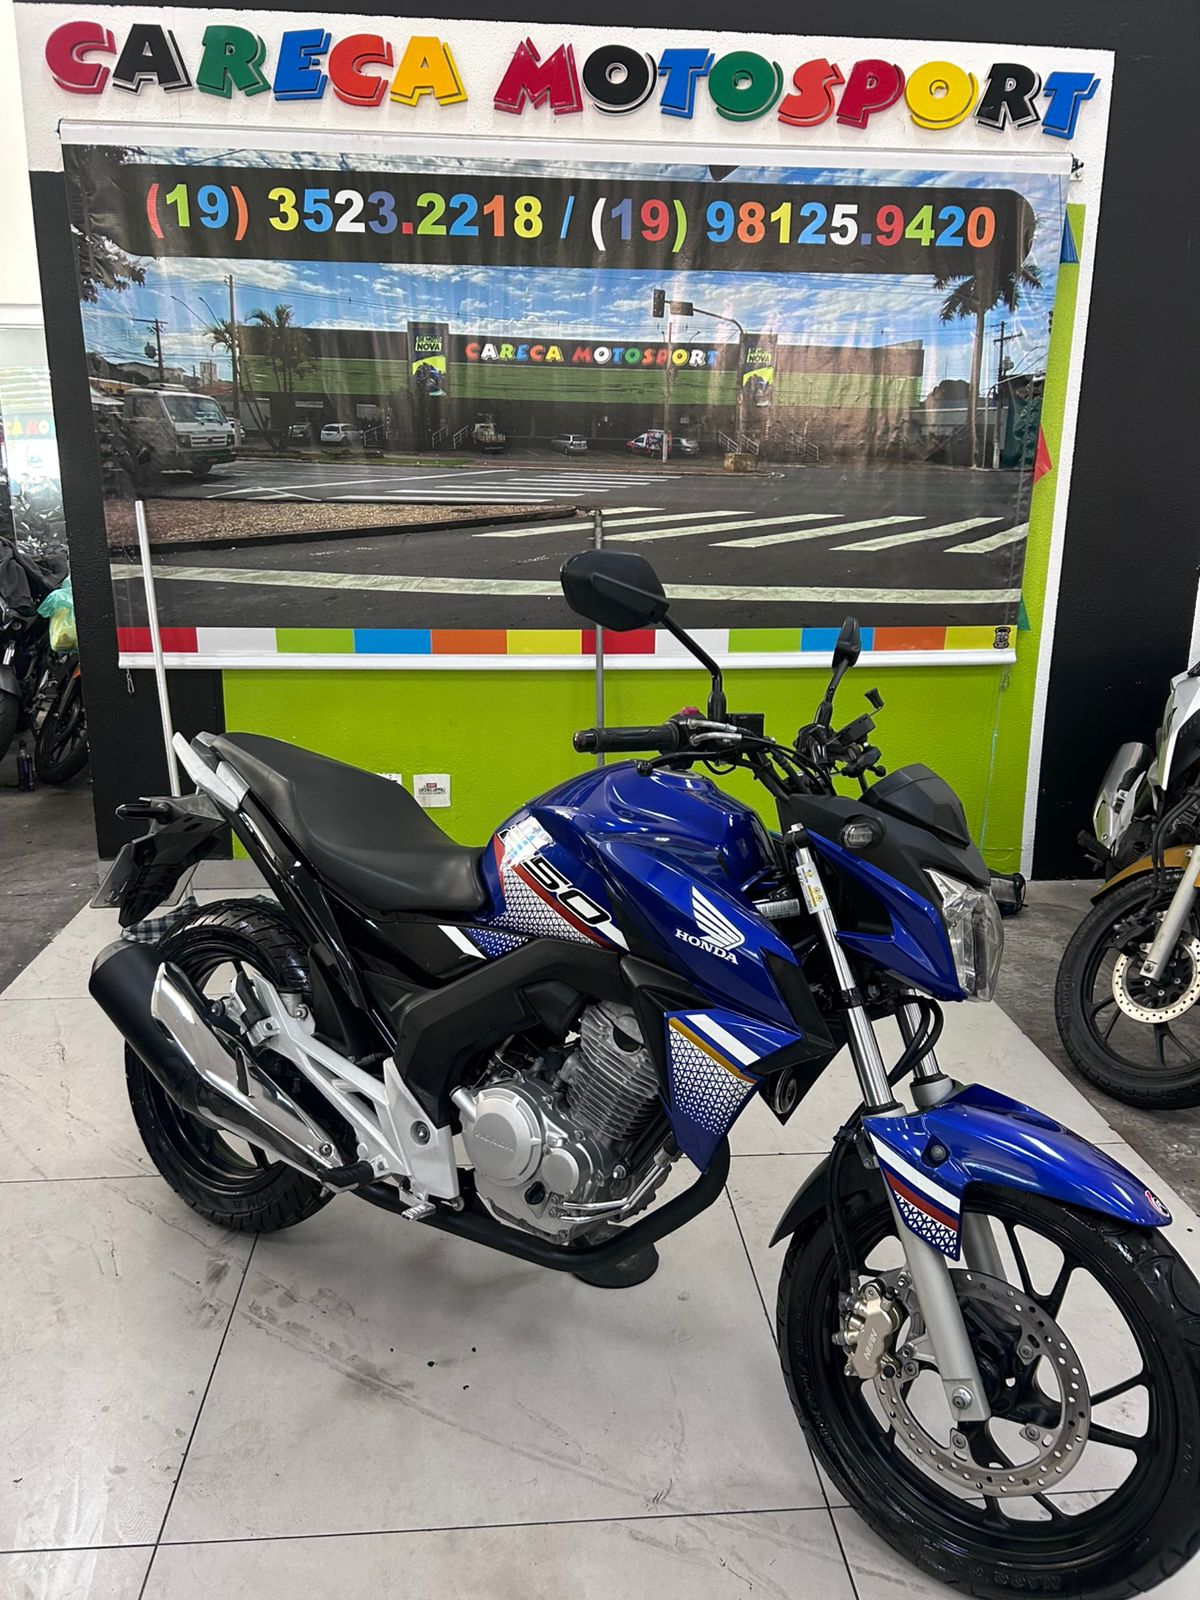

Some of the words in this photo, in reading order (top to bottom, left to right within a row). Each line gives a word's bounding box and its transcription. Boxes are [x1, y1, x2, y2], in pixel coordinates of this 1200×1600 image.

[45, 20, 468, 108] CARECA
[493, 36, 1100, 140] MOTOSPORT
[146, 183, 249, 241] (19)
[267, 187, 543, 239] 3523.2218
[591, 197, 688, 253] (19)
[706, 201, 995, 248] 98125.9420
[464, 342, 564, 363] CARECA
[572, 345, 718, 368] MOTOSPORT
[503, 832, 612, 926] 50
[674, 928, 739, 966] HONDA
